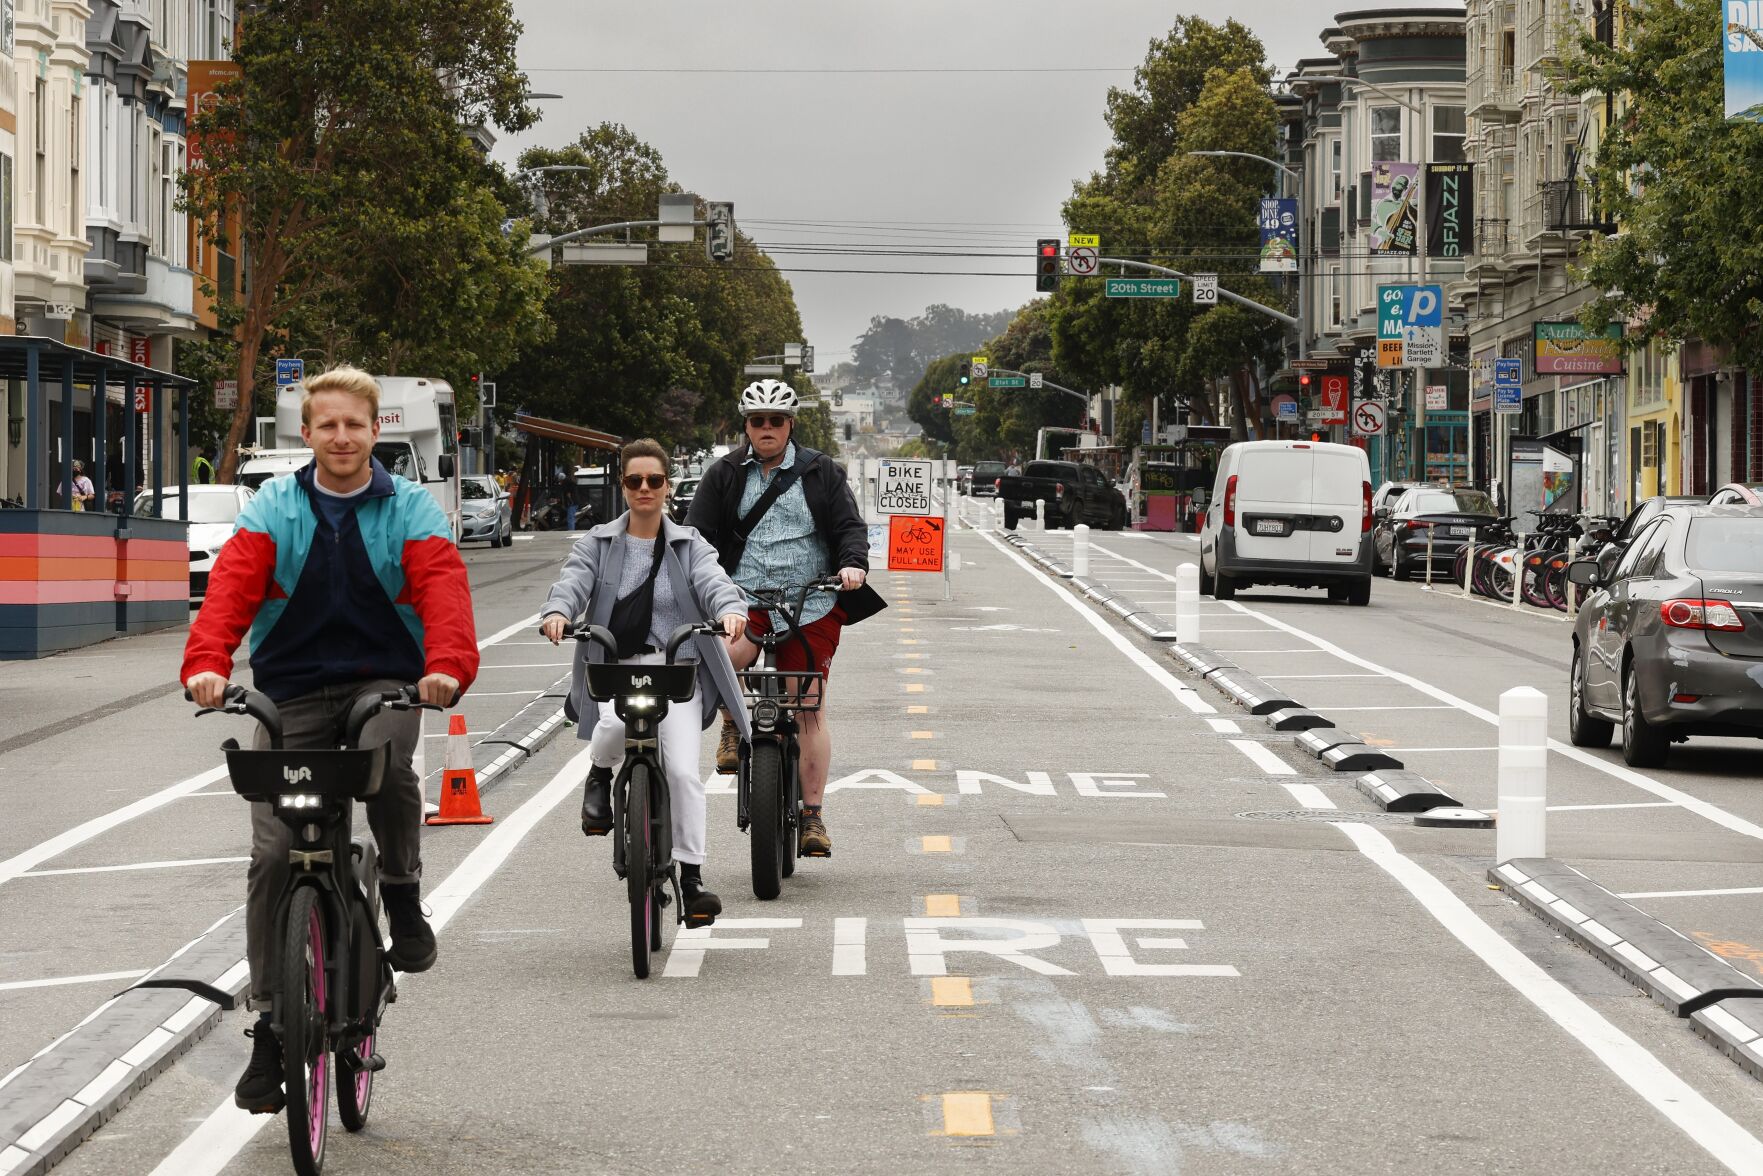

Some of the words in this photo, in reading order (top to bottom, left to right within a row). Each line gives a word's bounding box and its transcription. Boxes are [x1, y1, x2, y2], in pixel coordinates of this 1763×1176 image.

[1727, 1, 1763, 29] DI
[1728, 33, 1763, 53] SA
[1443, 175, 1458, 256] SFJAZZ
[1262, 219, 1280, 230] 49
[1110, 284, 1137, 293] 20th
[1140, 284, 1174, 293] Street
[1196, 289, 1214, 300] 20
[1553, 358, 1604, 370] Cuisine
[888, 466, 922, 478] BIKE
[886, 482, 924, 494] LANE
[880, 497, 928, 508] CLOSED
[892, 556, 912, 564] FULL
[917, 558, 938, 566] LANE
[631, 675, 652, 688] lyft
[283, 766, 312, 784] lyft
[662, 917, 1242, 977] FIRE
